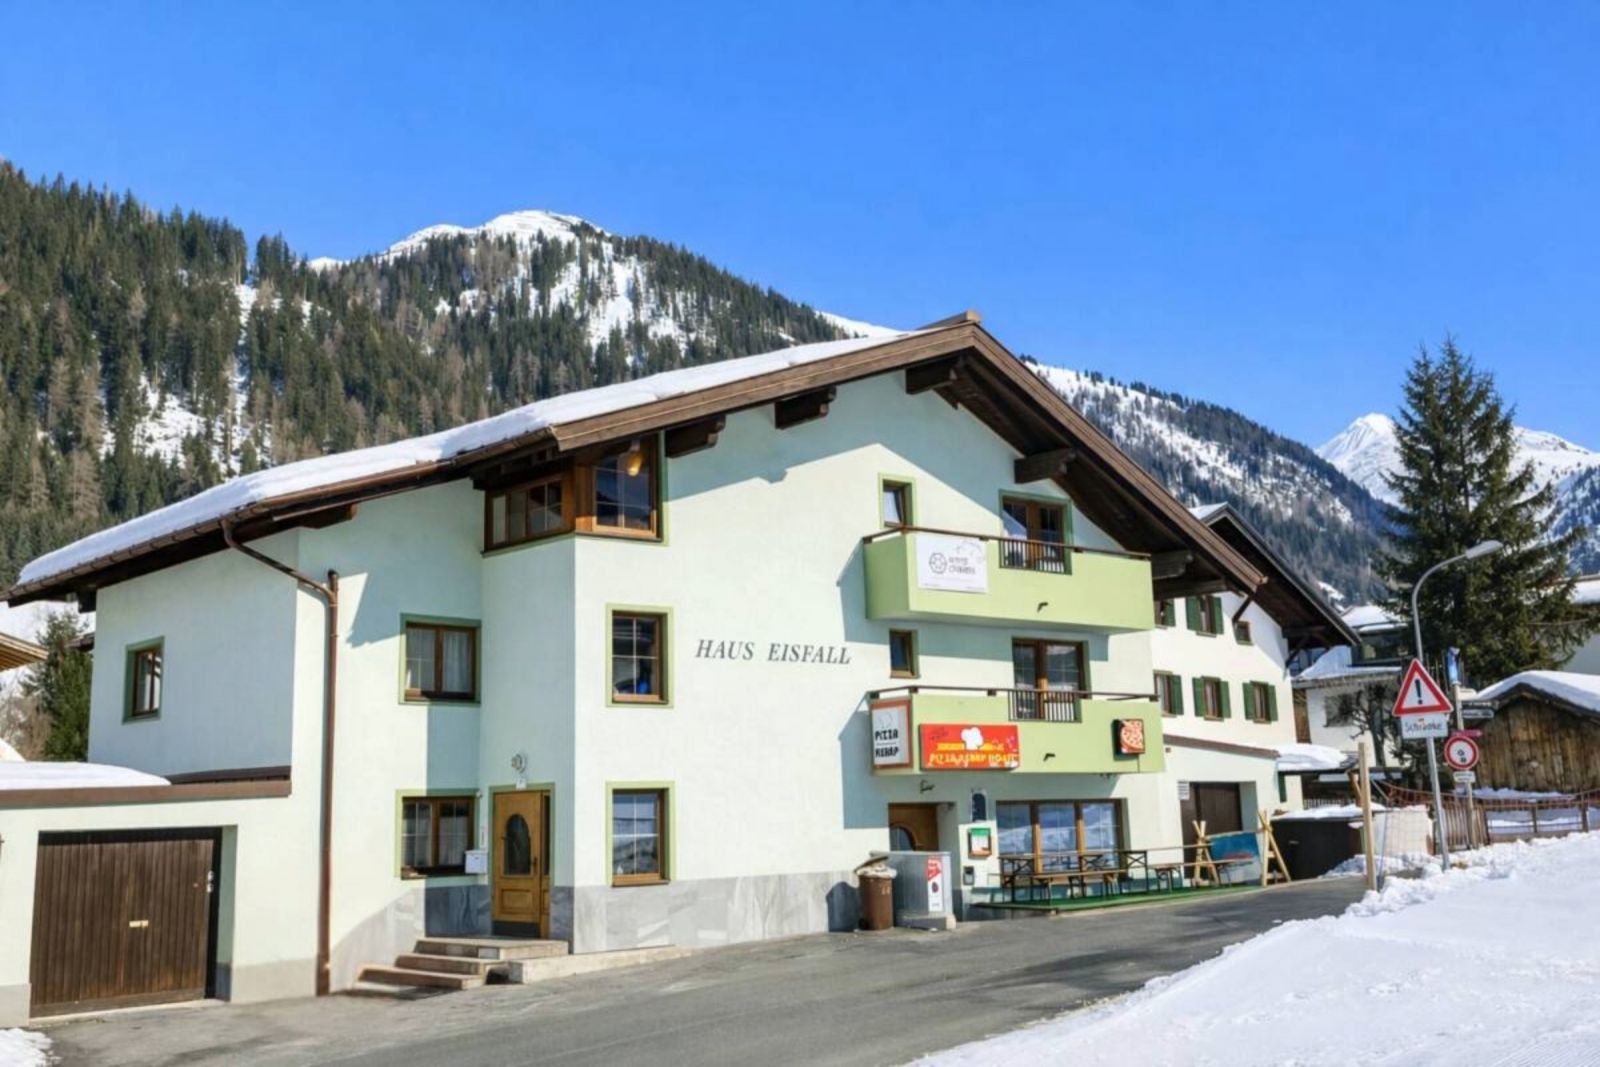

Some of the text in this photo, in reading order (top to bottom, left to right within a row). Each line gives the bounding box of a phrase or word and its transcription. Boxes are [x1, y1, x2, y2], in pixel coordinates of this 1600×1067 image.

[695, 639, 851, 665] HAUS EISFALL
[875, 729, 899, 740] PIZZA
